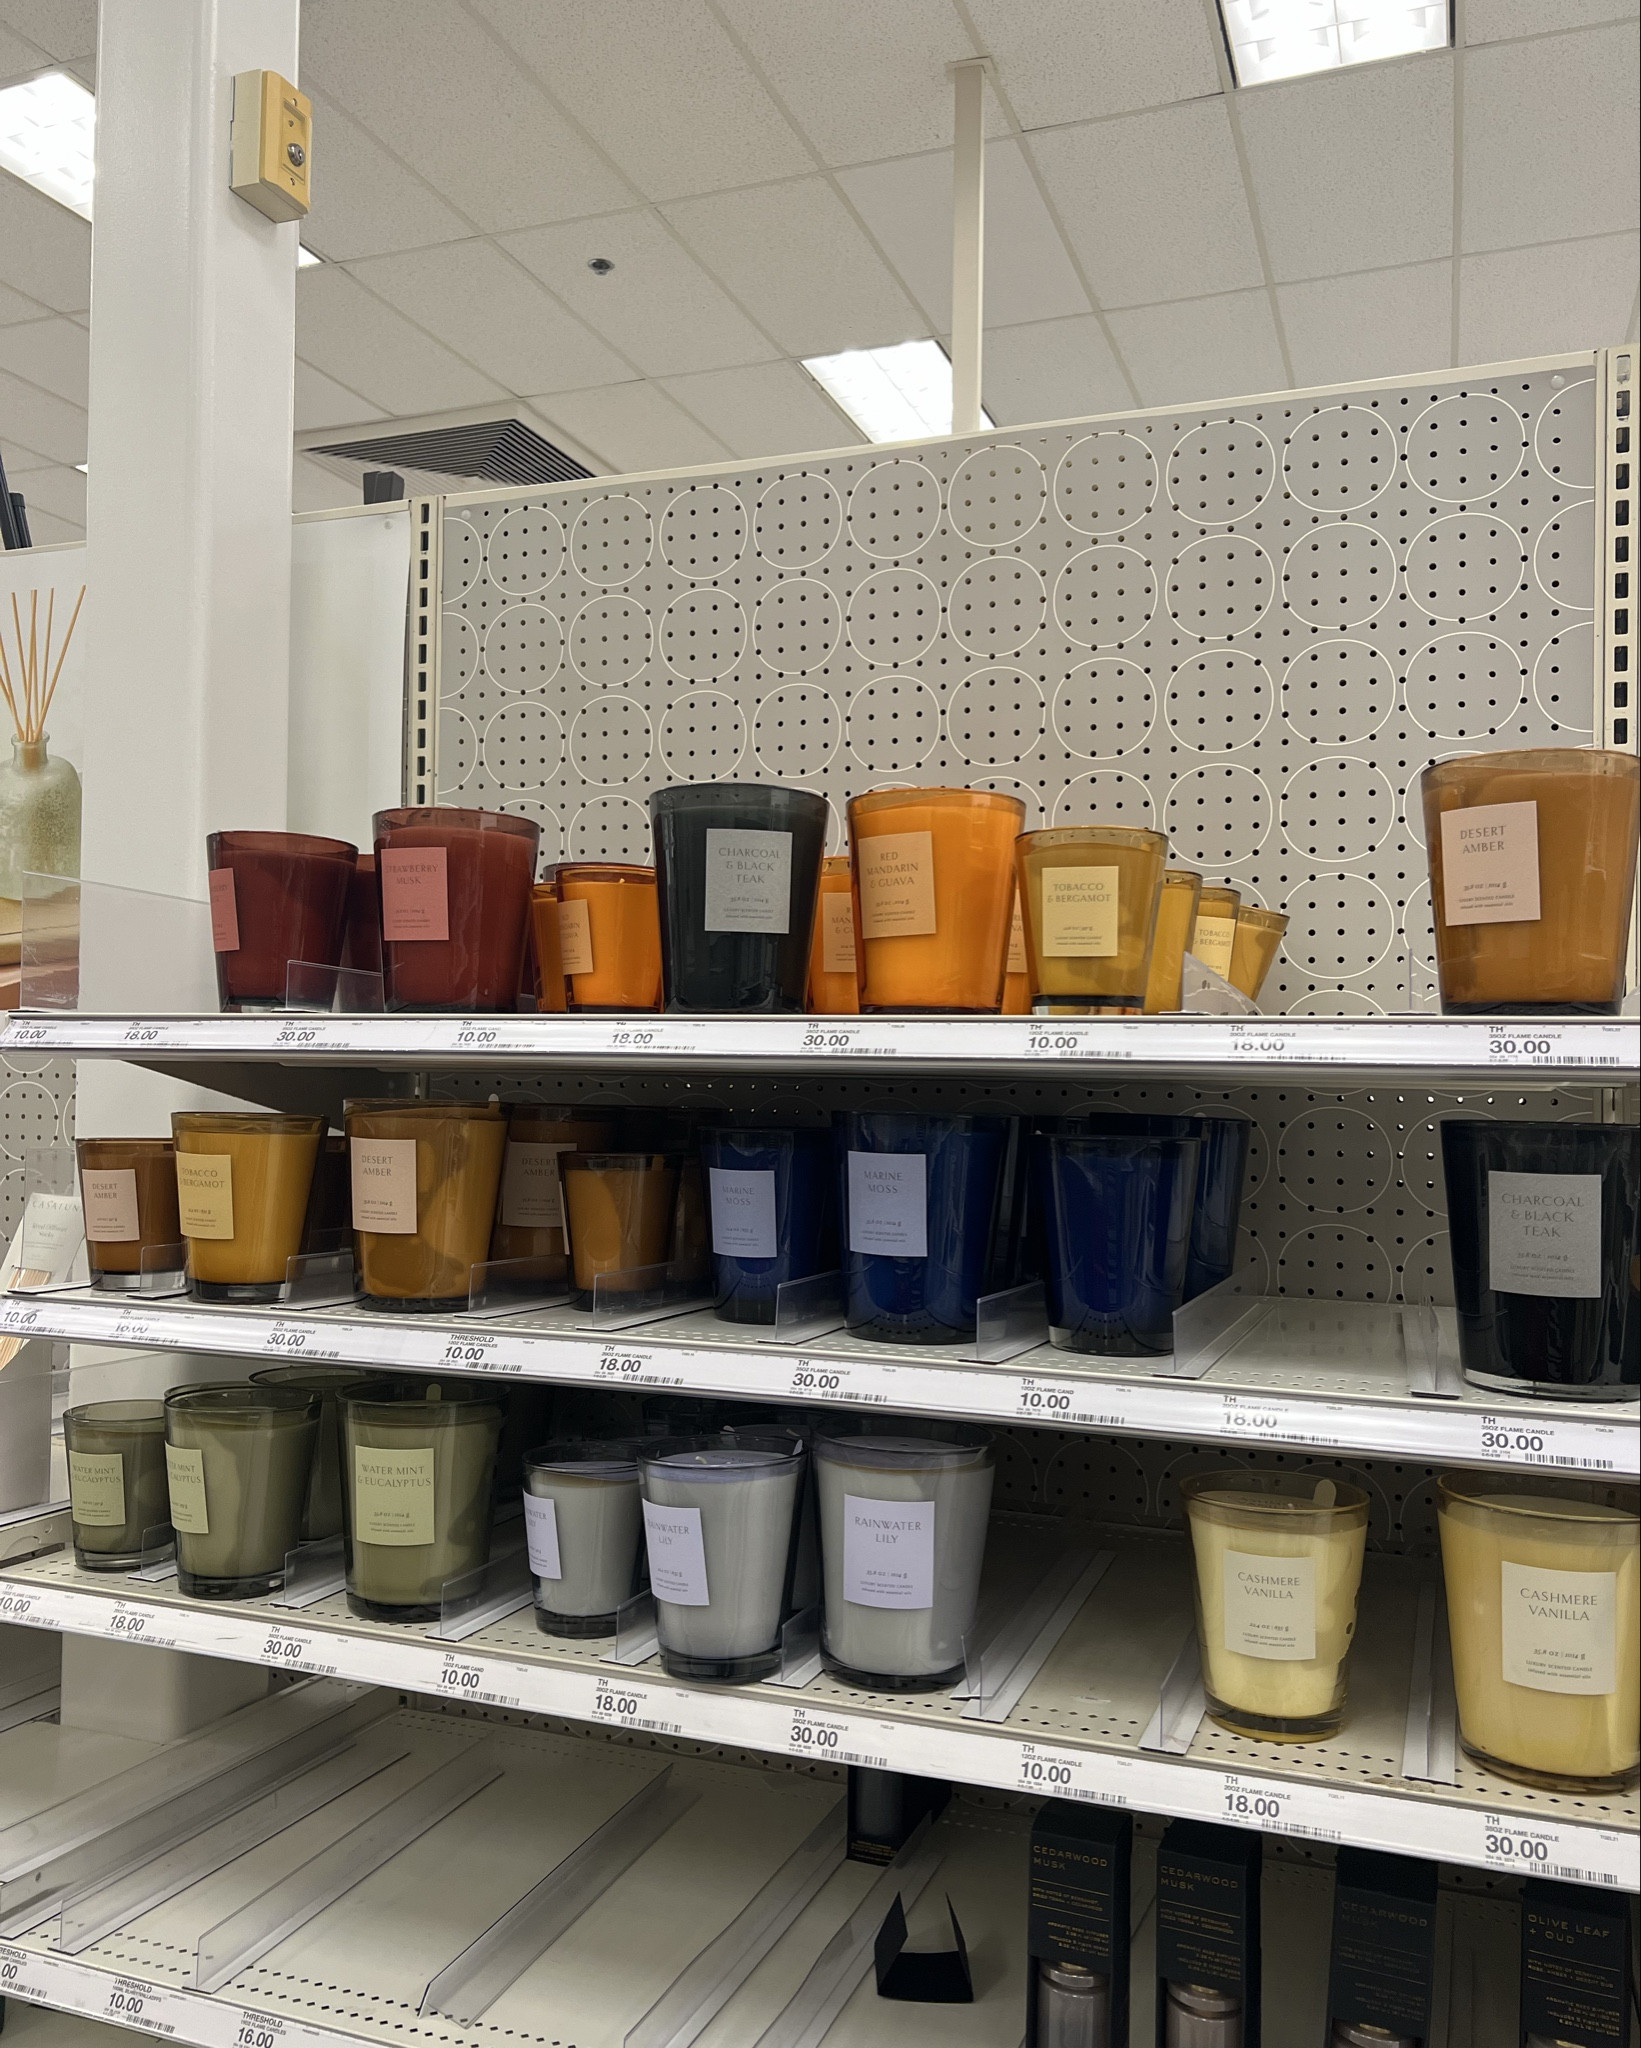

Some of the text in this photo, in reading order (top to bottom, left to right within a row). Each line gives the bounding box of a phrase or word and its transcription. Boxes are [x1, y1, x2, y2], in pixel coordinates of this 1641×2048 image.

[1460, 825, 1506, 840] DESERT
[718, 847, 781, 859] CHARCOAL
[1462, 840, 1504, 854] AMBER
[880, 852, 898, 861] RED
[726, 861, 774, 872] & BLACK
[866, 862, 918, 876] MANDARIN
[397, 876, 422, 885] MUSK
[737, 873, 765, 884] TEAK
[879, 876, 915, 888] GUAVA
[1053, 883, 1104, 892] TOBACCO
[1055, 894, 1112, 904] BERGAMOT
[1199, 929, 1229, 938] TOBACCO
[14, 1030, 47, 1039] 10.00
[123, 1030, 158, 1040] 18.00
[276, 1031, 315, 1041] 30.00
[457, 1031, 496, 1042] 10.00
[612, 1033, 653, 1044] 18.00
[802, 1034, 849, 1046] 30.00
[1028, 1037, 1077, 1049] 10.00
[1231, 1039, 1284, 1051] 18.00
[1489, 1040, 1551, 1054] 30.00
[361, 1154, 393, 1164] DESERT
[521, 1157, 557, 1166] DESERT
[362, 1167, 392, 1177] AMBER
[523, 1168, 555, 1177] AMBER
[864, 1170, 903, 1181] MARINE
[722, 1185, 755, 1195] MARINE
[868, 1184, 898, 1194] MOSS
[93, 1191, 118, 1200] AMBER
[726, 1196, 751, 1206] MOSS
[1502, 1193, 1585, 1207] CHARCOAL
[1524, 1211, 1574, 1223] BLACK
[1523, 1225, 1561, 1238] TEAK
[266, 1333, 305, 1347] 30.00
[450, 1334, 494, 1343] THRESHOLD
[445, 1346, 484, 1360] 10.00
[599, 1357, 642, 1373] 18.00
[792, 1373, 840, 1389] 30.00
[1022, 1377, 1034, 1385] TH
[1020, 1392, 1070, 1410] 10.00
[1223, 1395, 1236, 1403] TH
[1223, 1410, 1277, 1428] 18.00
[1481, 1416, 1496, 1425] TH
[1526, 1428, 1555, 1436] CANDLE
[1481, 1432, 1543, 1452] 30.00
[73, 1464, 115, 1474] WATER MINT
[361, 1464, 425, 1475] WATER MINT
[365, 1476, 432, 1488] EUCALYPTUS
[855, 1516, 921, 1531] RAINWATER
[659, 1535, 673, 1545] LILY
[875, 1533, 899, 1544] LILY
[1238, 1571, 1300, 1587] CASHMERE
[1244, 1586, 1293, 1600] VANILLA
[1520, 1588, 1598, 1606] CASHMERE
[1528, 1604, 1590, 1621] VANILLA
[110, 1614, 144, 1632] 18.00
[271, 1626, 281, 1634] TH
[263, 1640, 302, 1659] 30.00
[444, 1653, 455, 1662] TH
[440, 1669, 480, 1689] 10.00
[597, 1678, 609, 1687] TH
[595, 1694, 638, 1715] 18.00
[793, 1709, 805, 1718] TH
[807, 1720, 827, 1728] FLAME
[827, 1723, 849, 1731] CANDLE
[791, 1725, 838, 1748] 30.00
[1022, 1744, 1035, 1754] TH
[1058, 1759, 1083, 1768] CANDLE
[1021, 1761, 1071, 1785] 10.00
[1225, 1775, 1239, 1785] TH
[1242, 1787, 1264, 1795] FLAME
[1265, 1791, 1291, 1800] CANDLE
[1225, 1793, 1280, 1818] 18.00
[1485, 1815, 1500, 1825] TH
[1504, 1827, 1529, 1836] FLAME
[1530, 1832, 1560, 1842] CANDLE
[1486, 1834, 1548, 1861] 30.00
[1033, 1845, 1108, 1867] CEDARWOOD
[1034, 1857, 1066, 1870] MUSK
[1160, 1865, 1239, 1889] CEDARWOOD
[1160, 1877, 1195, 1891] MUSK
[1341, 1901, 1428, 1927] CEDARWOOD
[1528, 1914, 1610, 1938] OLIVE LEAF
[1545, 1930, 1575, 1944] OUD
[114, 1977, 153, 1994] THRESHOLD
[110, 1992, 144, 2014] 10.00
[242, 2011, 283, 2028] THRESHOLD
[238, 2027, 274, 2048] 16.00
